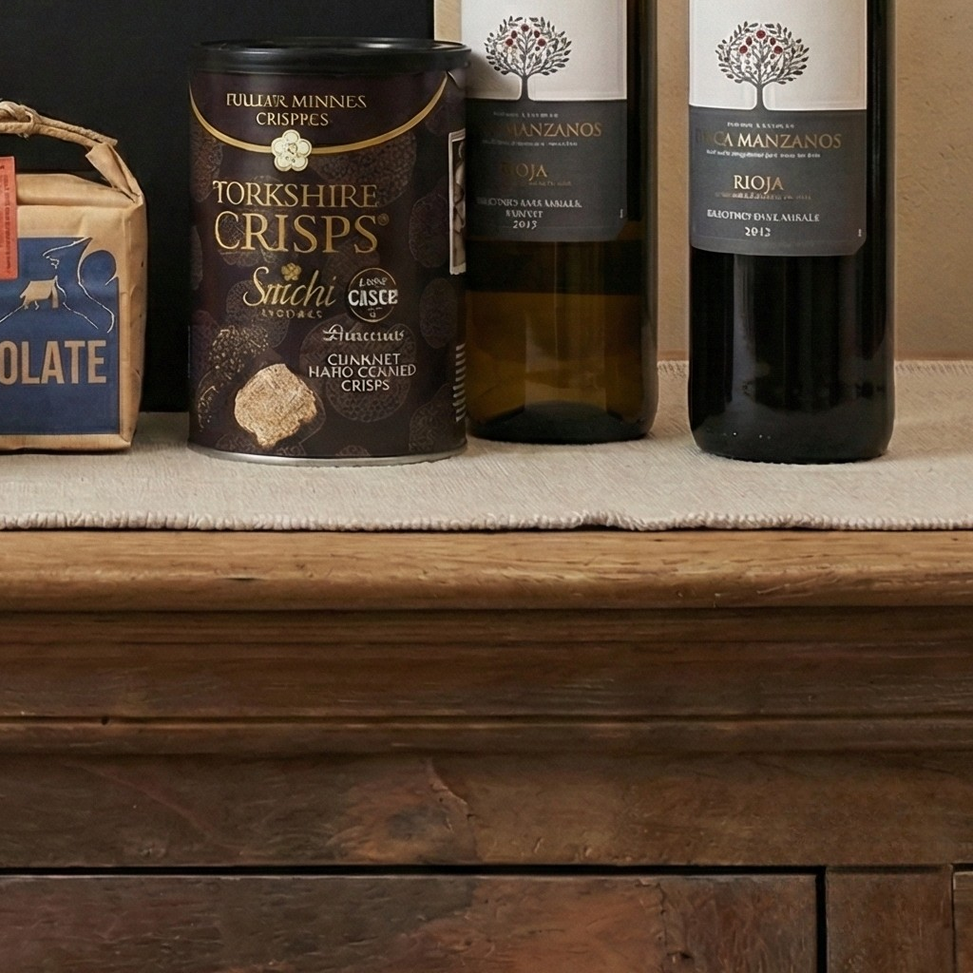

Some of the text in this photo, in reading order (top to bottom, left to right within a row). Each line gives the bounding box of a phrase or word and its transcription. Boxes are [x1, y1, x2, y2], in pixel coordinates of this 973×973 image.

[292, 94, 367, 108] MINNES
[737, 132, 842, 149] MANZANOS
[733, 174, 784, 195] RIOJA
[214, 210, 378, 254] CRISPS
[341, 379, 390, 392] CRISPS
